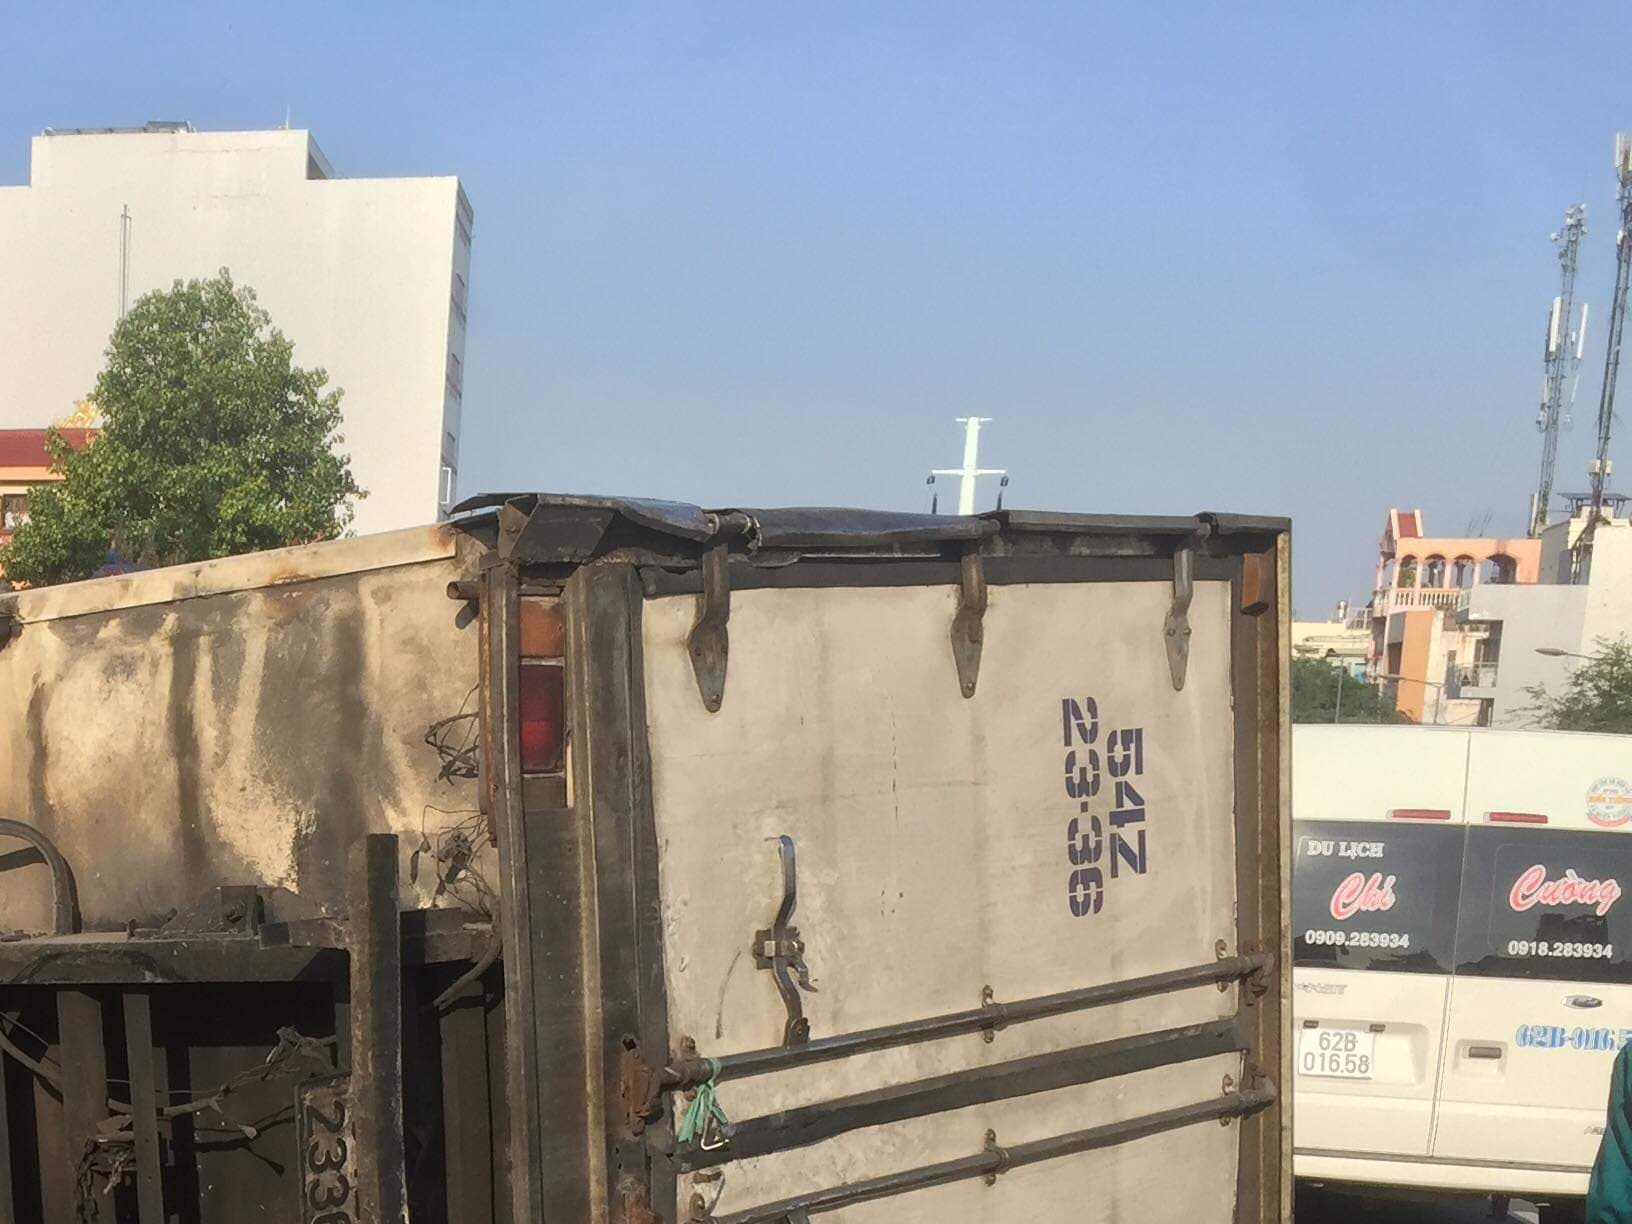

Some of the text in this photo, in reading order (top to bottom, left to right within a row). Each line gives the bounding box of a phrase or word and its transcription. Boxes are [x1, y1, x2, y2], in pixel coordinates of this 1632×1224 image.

[1307, 840, 1384, 860] DU LỊCH
[1510, 864, 1621, 916] Cường
[1305, 930, 1410, 948] 0909.283934
[1508, 941, 1613, 958] 0918.283934
[1319, 1032, 1357, 1052] 62B
[1304, 1052, 1370, 1074] 016.58
